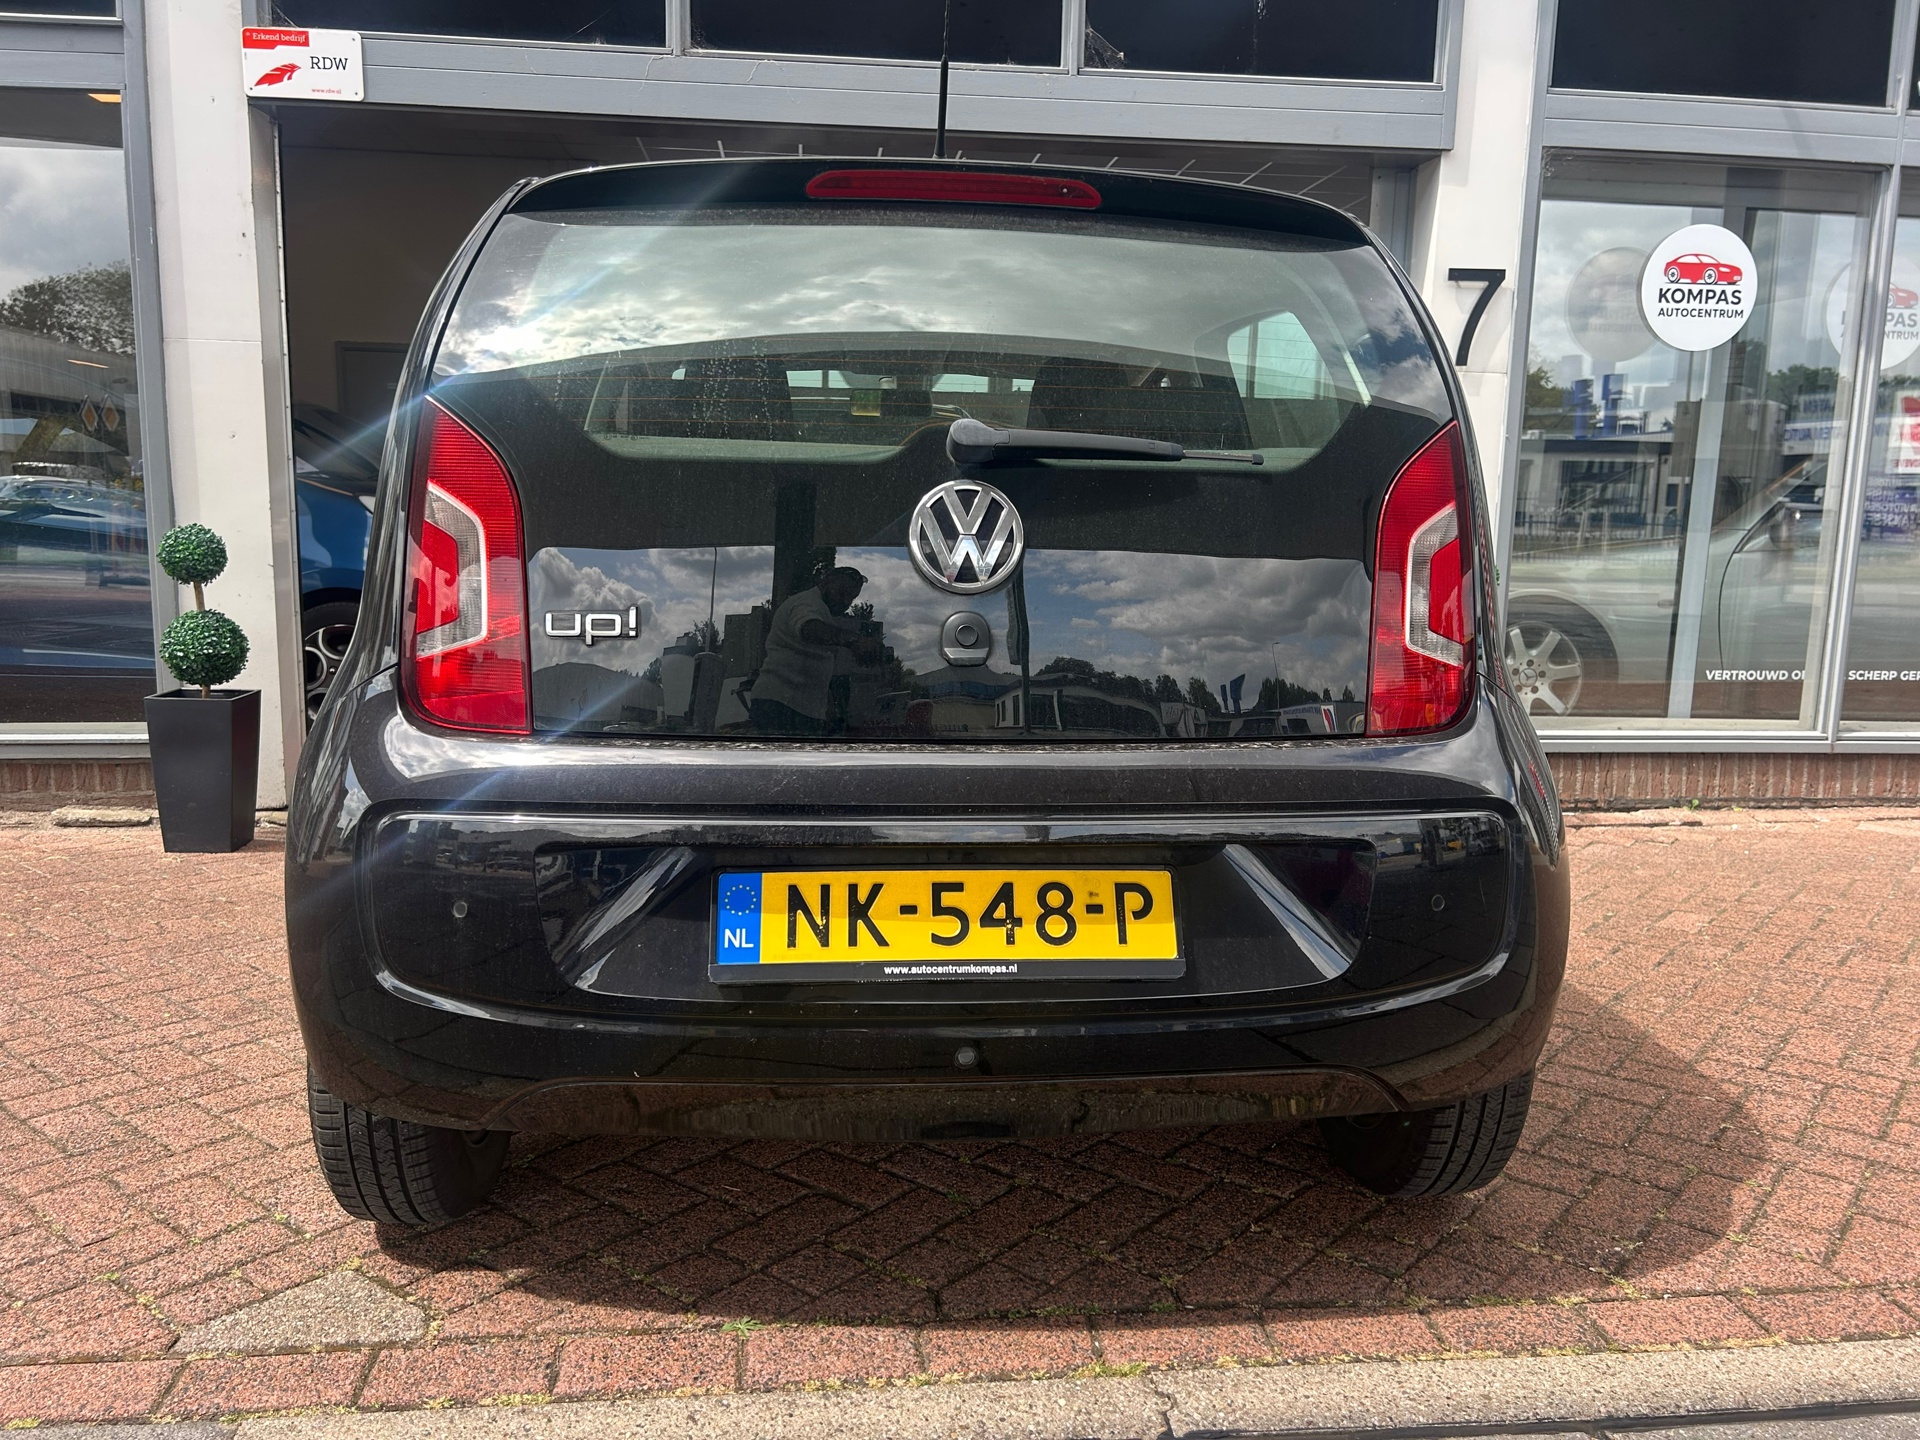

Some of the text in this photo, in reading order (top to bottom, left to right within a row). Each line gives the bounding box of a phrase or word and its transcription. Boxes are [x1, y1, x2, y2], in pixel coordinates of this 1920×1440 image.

[252, 32, 306, 44] Erkend bedrijf
[310, 56, 348, 71] RDW
[1657, 287, 1742, 305] KOMPAS
[1448, 268, 1506, 366] 7
[1657, 307, 1744, 319] AUTOCENTRUM
[545, 606, 638, 645] up!
[1705, 670, 1789, 681] VERTROUWD
[1847, 671, 1898, 681] SCHERP
[786, 881, 1154, 949] NK-548-P
[723, 928, 754, 949] NL
[884, 963, 1018, 975] www.autocentrumkompas.nl
